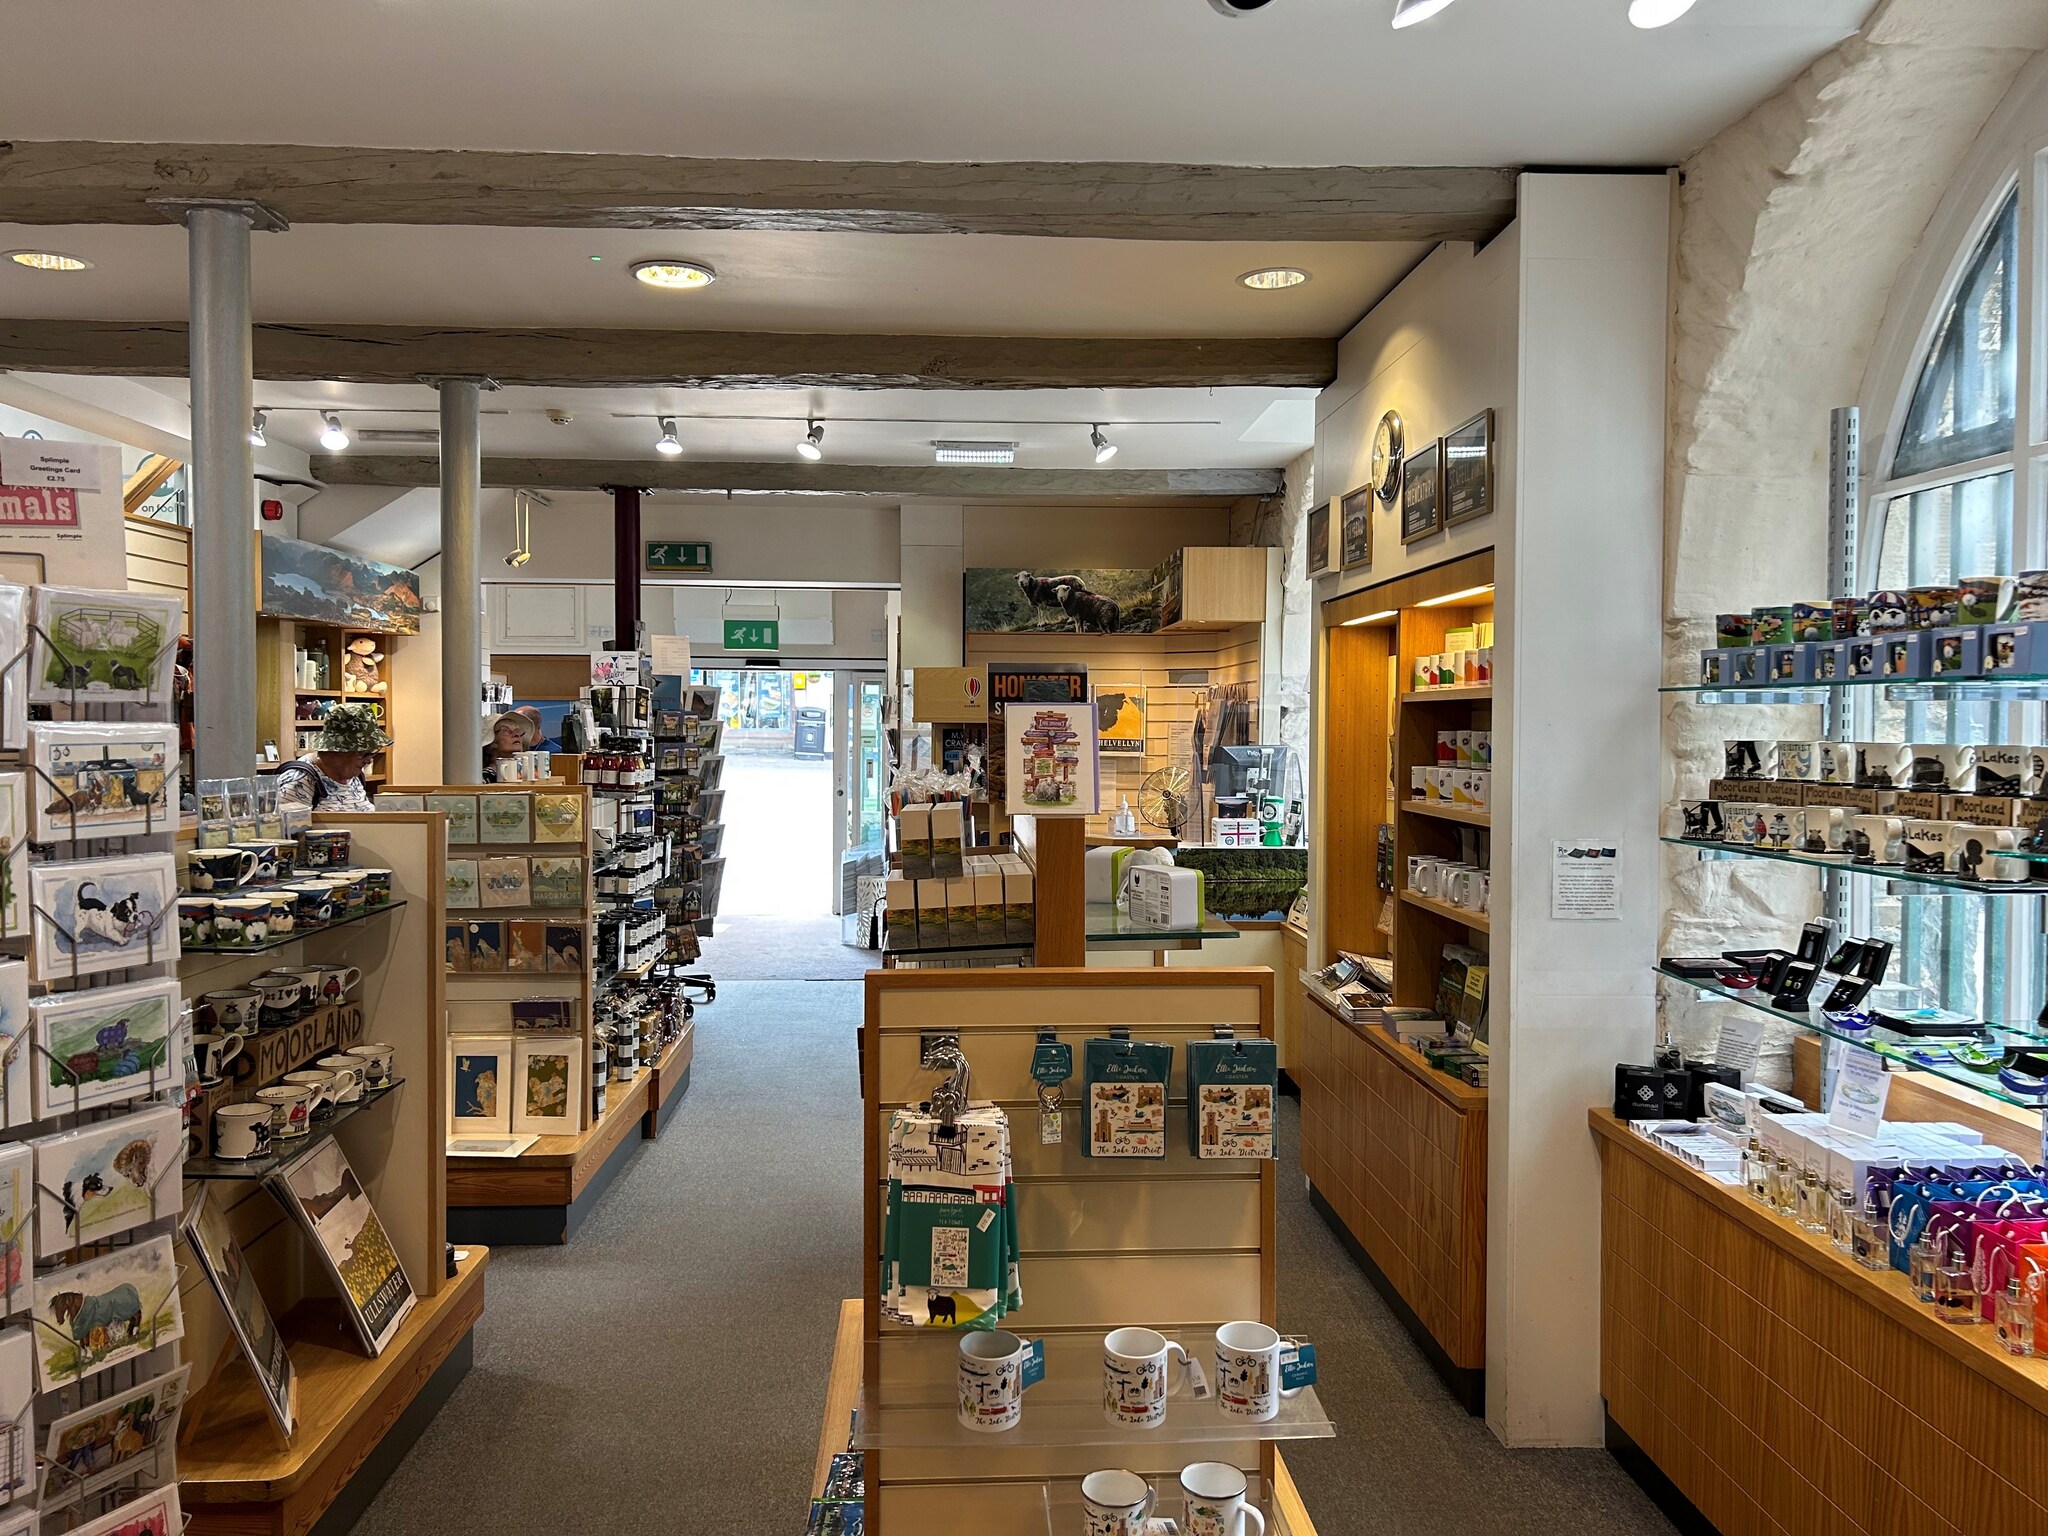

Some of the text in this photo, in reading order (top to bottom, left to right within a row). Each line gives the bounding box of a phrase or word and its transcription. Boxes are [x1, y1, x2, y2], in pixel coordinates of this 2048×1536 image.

[40, 456, 70, 465] Splimple
[30, 465, 63, 475] Greetings
[141, 504, 155, 512] on
[994, 674, 1081, 698] HONR
[1098, 739, 1140, 747] HELVELLYN
[1714, 781, 1760, 794] Moorland
[1766, 784, 1797, 795] Moorland
[1897, 793, 1933, 808] Moorland
[1954, 798, 2005, 816] Moorland
[259, 1008, 362, 1082] MOORLAND
[1037, 1066, 1067, 1075] Ellie Jackson
[1106, 1063, 1148, 1075] Ellie Jackson
[1215, 1063, 1257, 1074] Ellie Jackson
[1632, 1101, 1659, 1109] dunmail
[1096, 1145, 1163, 1155] The Lake District
[1203, 1148, 1270, 1157] The Lake District
[364, 1269, 405, 1325] ULLSWATER
[1284, 1361, 1314, 1373] Ellie Jackson
[1245, 1405, 1271, 1416] District
[975, 1417, 986, 1425] The
[1116, 1413, 1127, 1422] The
